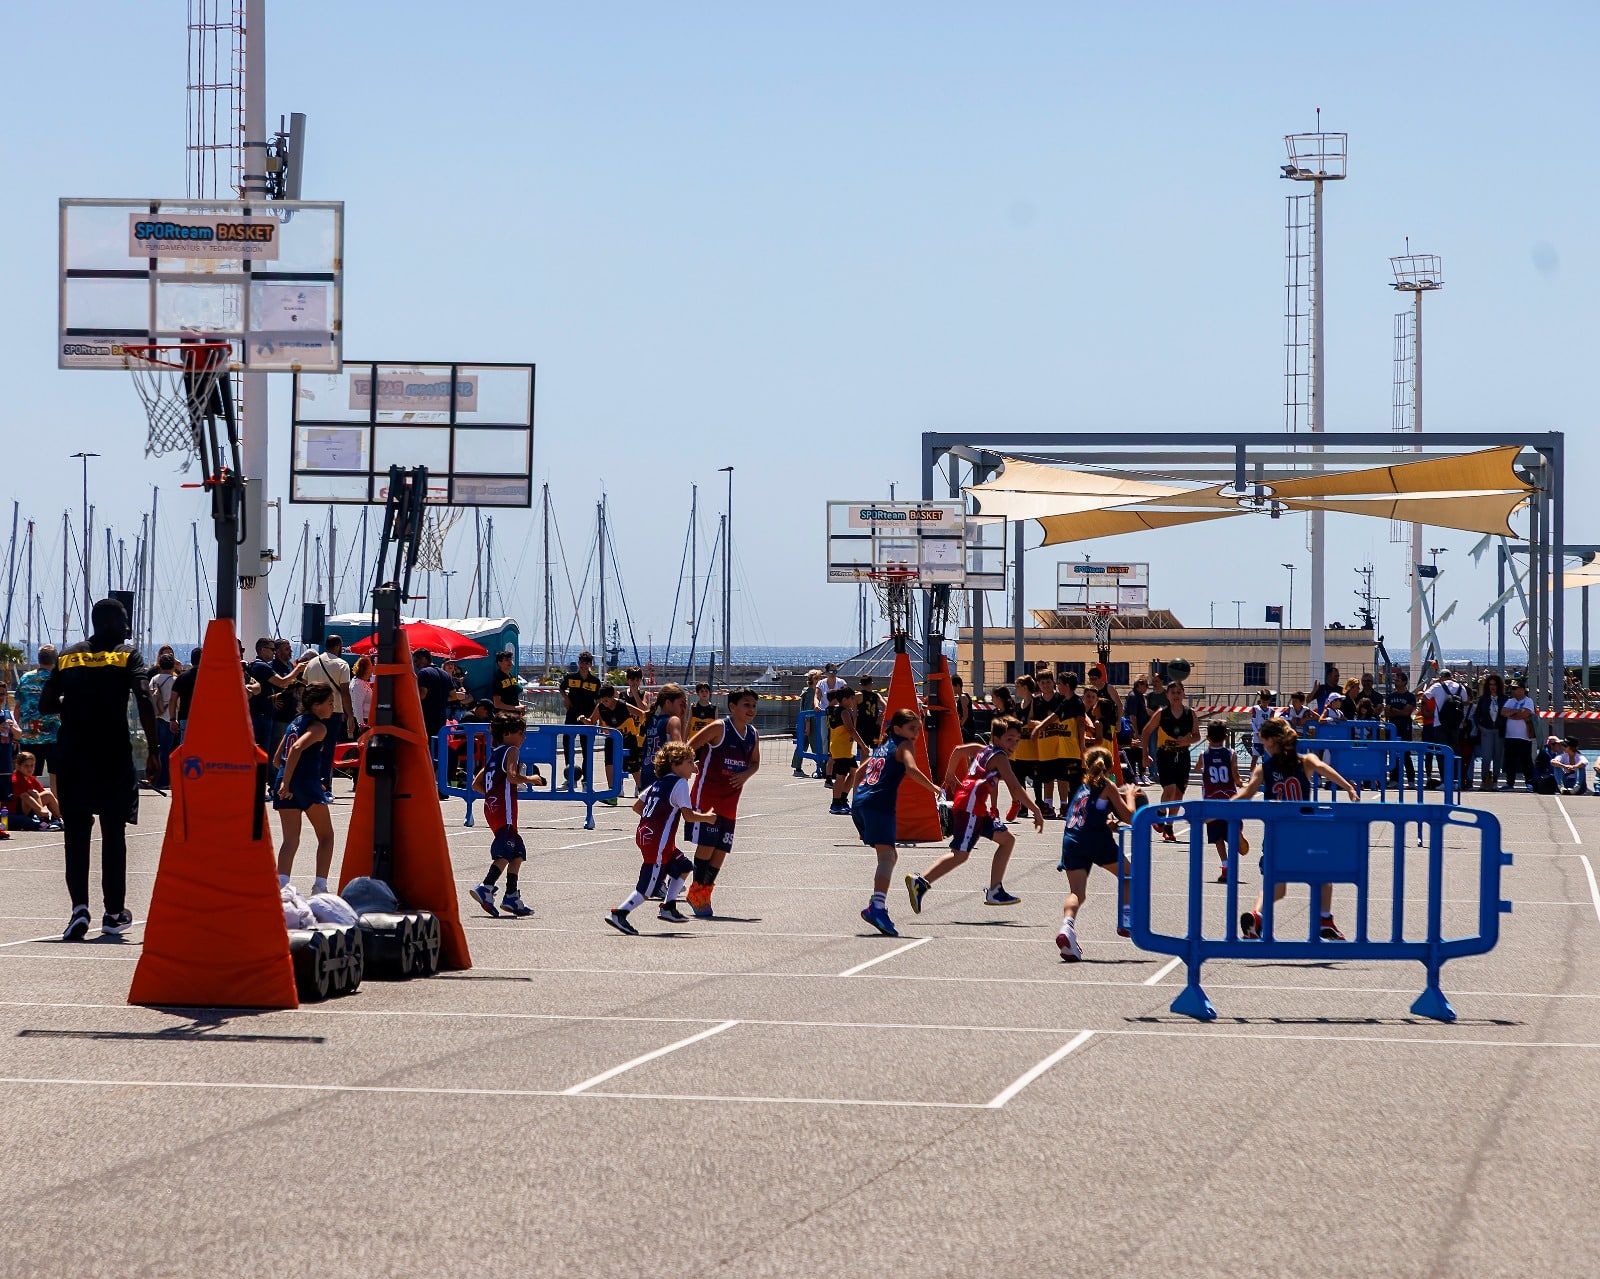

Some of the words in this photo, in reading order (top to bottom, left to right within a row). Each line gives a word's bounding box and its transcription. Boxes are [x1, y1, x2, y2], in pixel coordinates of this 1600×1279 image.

[135, 222, 213, 240] SPORteam
[216, 223, 274, 241] BASKET
[291, 314, 298, 322] 6
[64, 344, 110, 356] SPORteam
[860, 509, 906, 520] SPORteam
[909, 510, 943, 520] BASKET
[1209, 765, 1229, 784] 90
